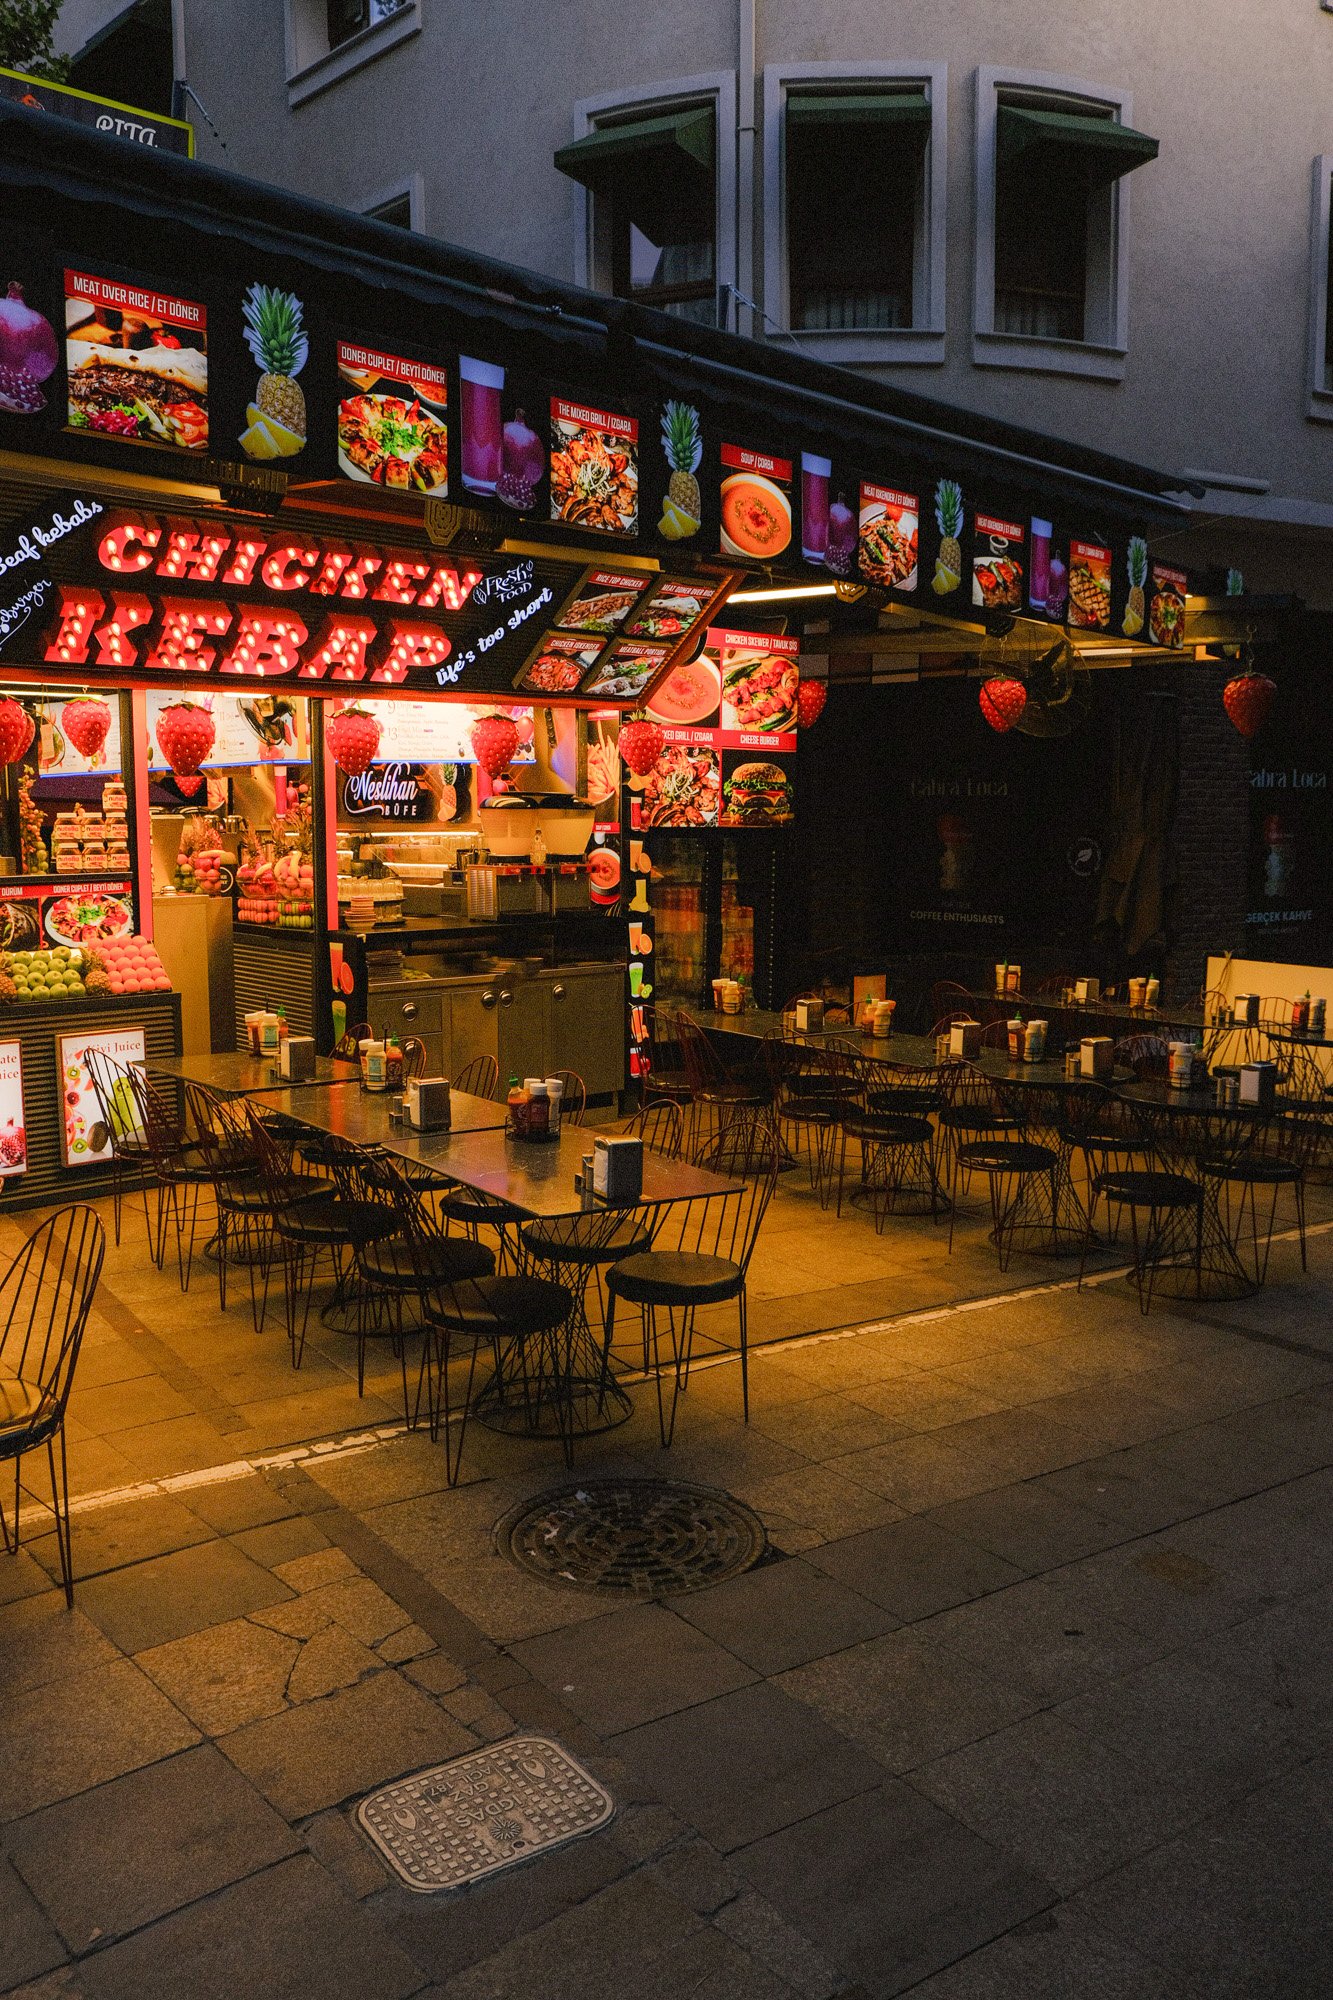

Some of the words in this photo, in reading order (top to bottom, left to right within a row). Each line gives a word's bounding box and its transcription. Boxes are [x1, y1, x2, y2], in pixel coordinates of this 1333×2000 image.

[73, 276, 101, 296] MEAT
[102, 283, 127, 304] OVER
[128, 291, 150, 309] RICE
[150, 296, 156, 313] /
[157, 299, 168, 313] ET
[169, 301, 199, 322] DÖNER
[367, 353, 395, 372] CUPLET
[395, 360, 400, 376] /
[421, 367, 446, 385] DÖNER
[558, 402, 570, 417] THE
[570, 406, 590, 422] MIXED
[590, 412, 607, 427] GRILL
[606, 416, 611, 429] /
[740, 452, 754, 465] SOUP
[863, 485, 876, 498] MEAT
[31, 500, 104, 547] kebabs
[98, 523, 484, 610] CHICKEN
[619, 578, 645, 588] CHICKEN
[44, 600, 452, 684] KEBAP
[435, 650, 476, 686] life's
[477, 626, 505, 653] too
[507, 587, 553, 630] short
[550, 639, 575, 648] CHICKEN
[725, 633, 748, 645] CHICKEN
[748, 635, 770, 647] SKEWER
[773, 639, 790, 650] TAVUK
[618, 646, 646, 655] MEATBALL
[675, 730, 690, 741] GRILL
[740, 734, 759, 745] CHEESE
[759, 736, 780, 746] BURGER
[346, 762, 419, 803] Neslihan
[1292, 768, 1327, 788] Loca
[384, 803, 418, 816] BÜFE
[910, 910, 942, 921] COFFEE
[943, 911, 1005, 925] ENTHUSIASTS
[1282, 909, 1313, 922] KAHVE
[114, 1041, 142, 1054] Juice
[431, 1782, 454, 1797] 187
[449, 1781, 489, 1802] GAZ
